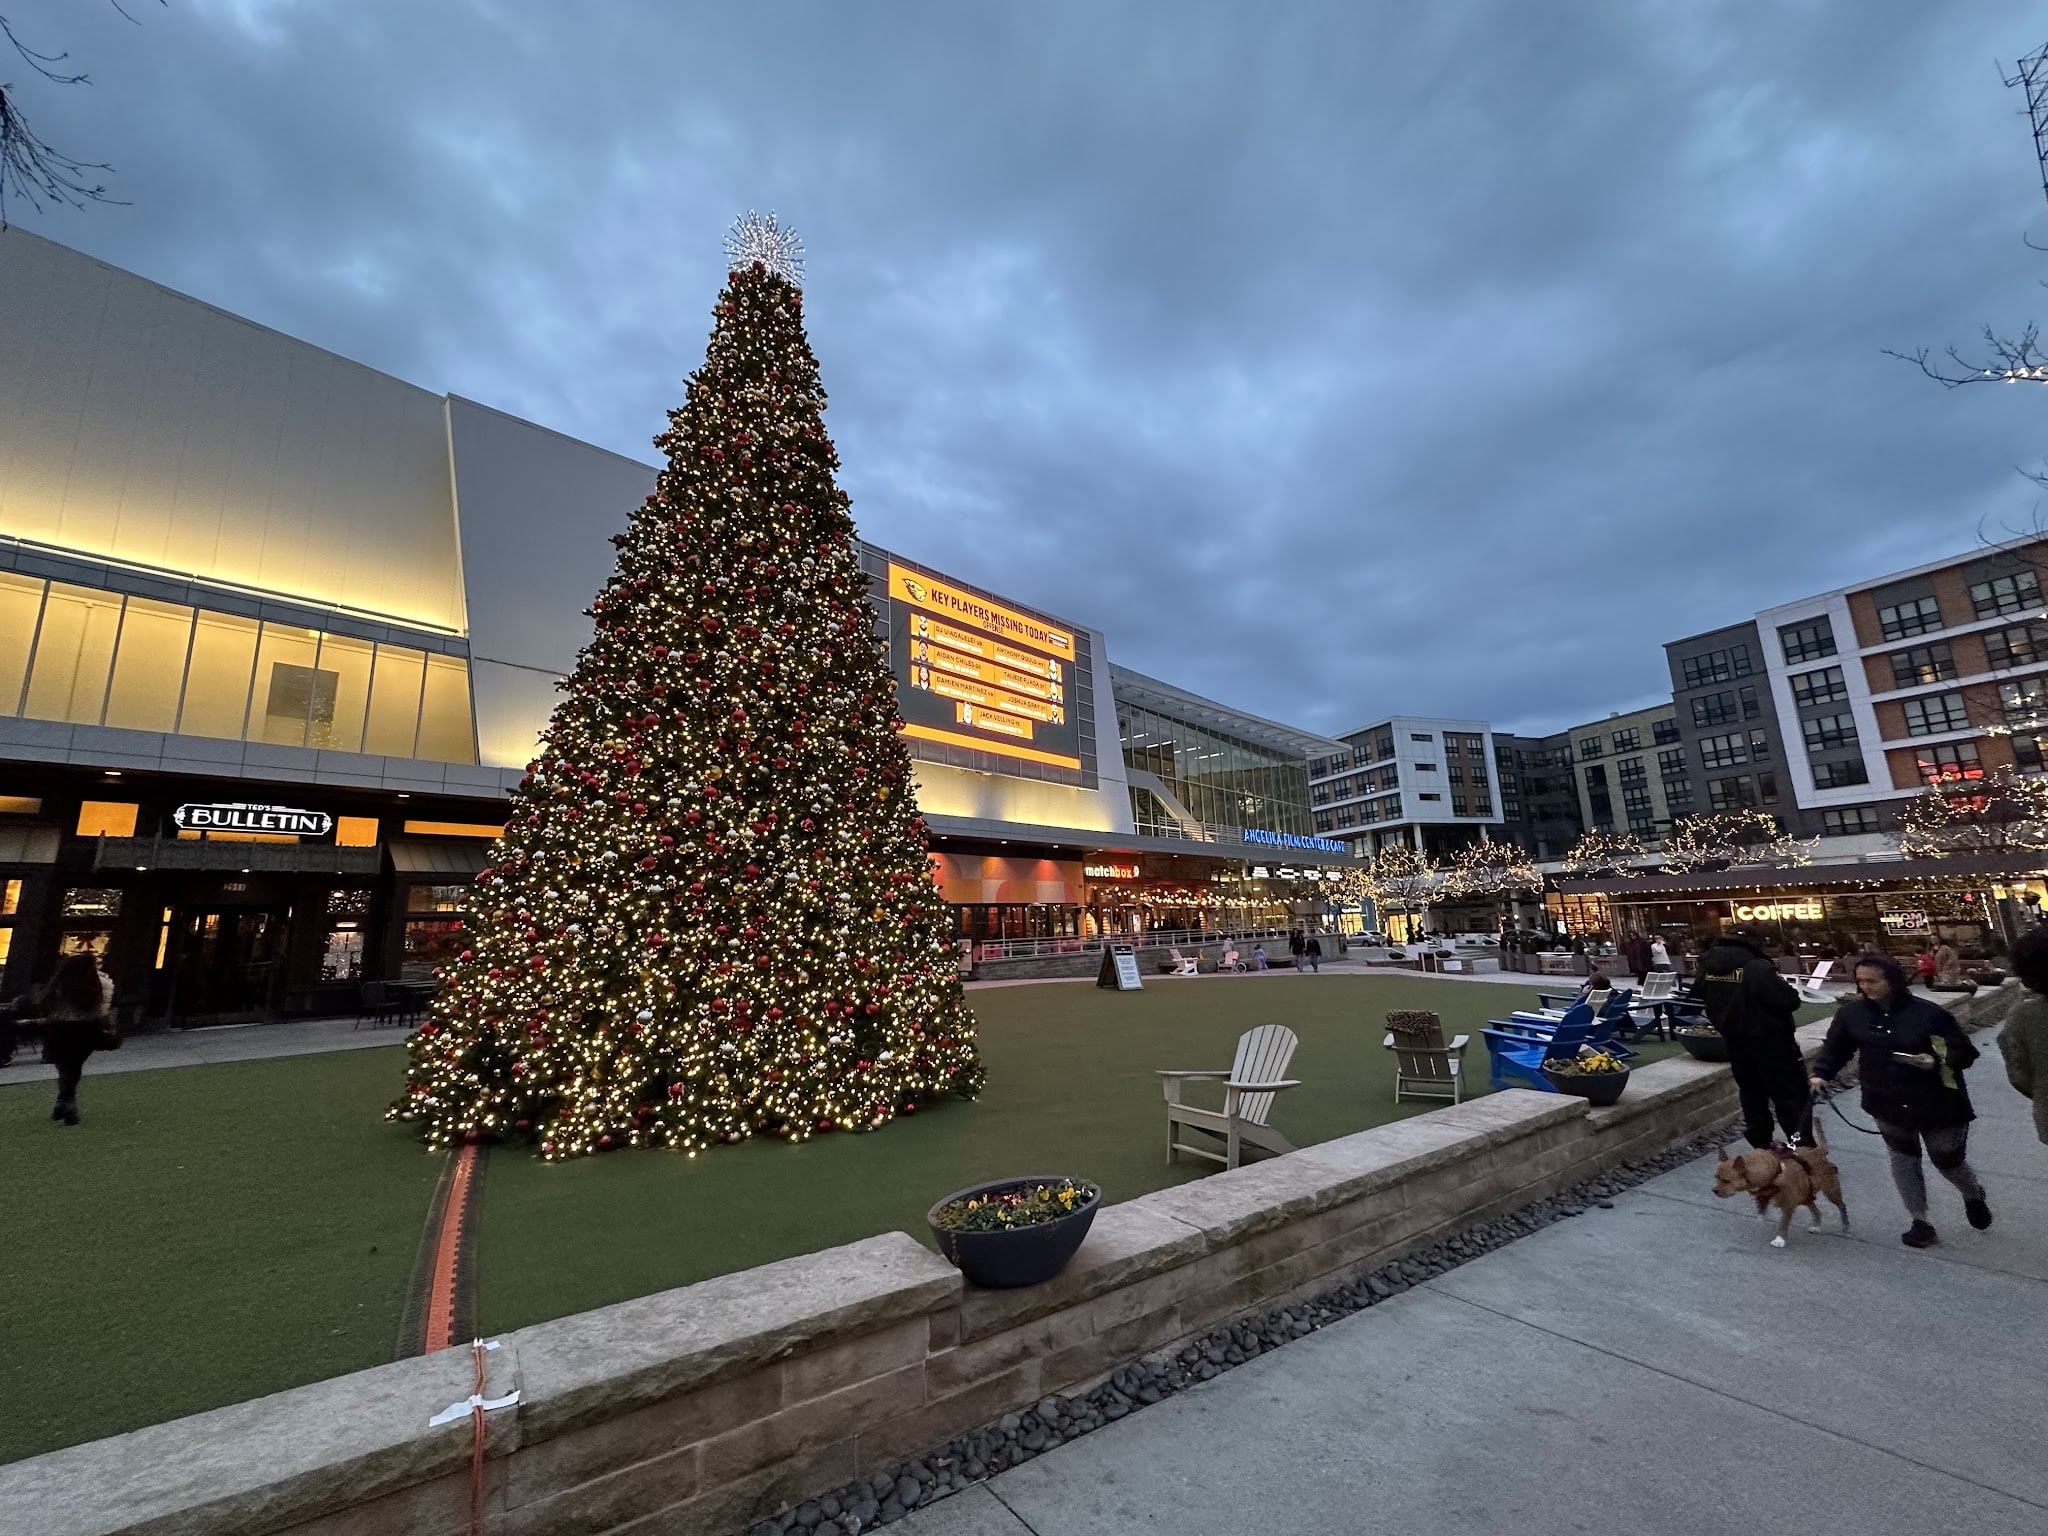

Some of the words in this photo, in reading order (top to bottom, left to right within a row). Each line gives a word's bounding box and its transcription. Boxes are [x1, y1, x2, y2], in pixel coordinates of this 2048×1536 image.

[931, 589, 949, 606] KEY
[952, 596, 989, 621] PLAYERS
[991, 611, 1023, 634] MISSING
[1025, 624, 1048, 643] TODAY
[935, 625, 943, 633] DJ
[983, 620, 1004, 634] OFFENSE
[936, 651, 955, 663] AIDAN
[955, 656, 975, 667] CHILES
[996, 646, 1020, 658] ANTHONY
[1021, 655, 1037, 665] GOULD
[936, 676, 960, 688] DAMIEN
[960, 682, 988, 696] MARTINEZ
[1007, 696, 1027, 706] JOSHUA
[1027, 701, 1040, 709] GRAY
[980, 711, 993, 719] JACK
[191, 809, 318, 831] BULLETIN
[1244, 828, 1282, 845] ANGELIKA
[1283, 833, 1300, 848] FILM
[1301, 836, 1325, 850] CENTER
[1330, 840, 1345, 852] CAFE
[1085, 865, 1133, 878] matchbox
[1736, 903, 1823, 921] COFFEE
[1888, 912, 1922, 922] MOM
[1896, 920, 1924, 929] POP
